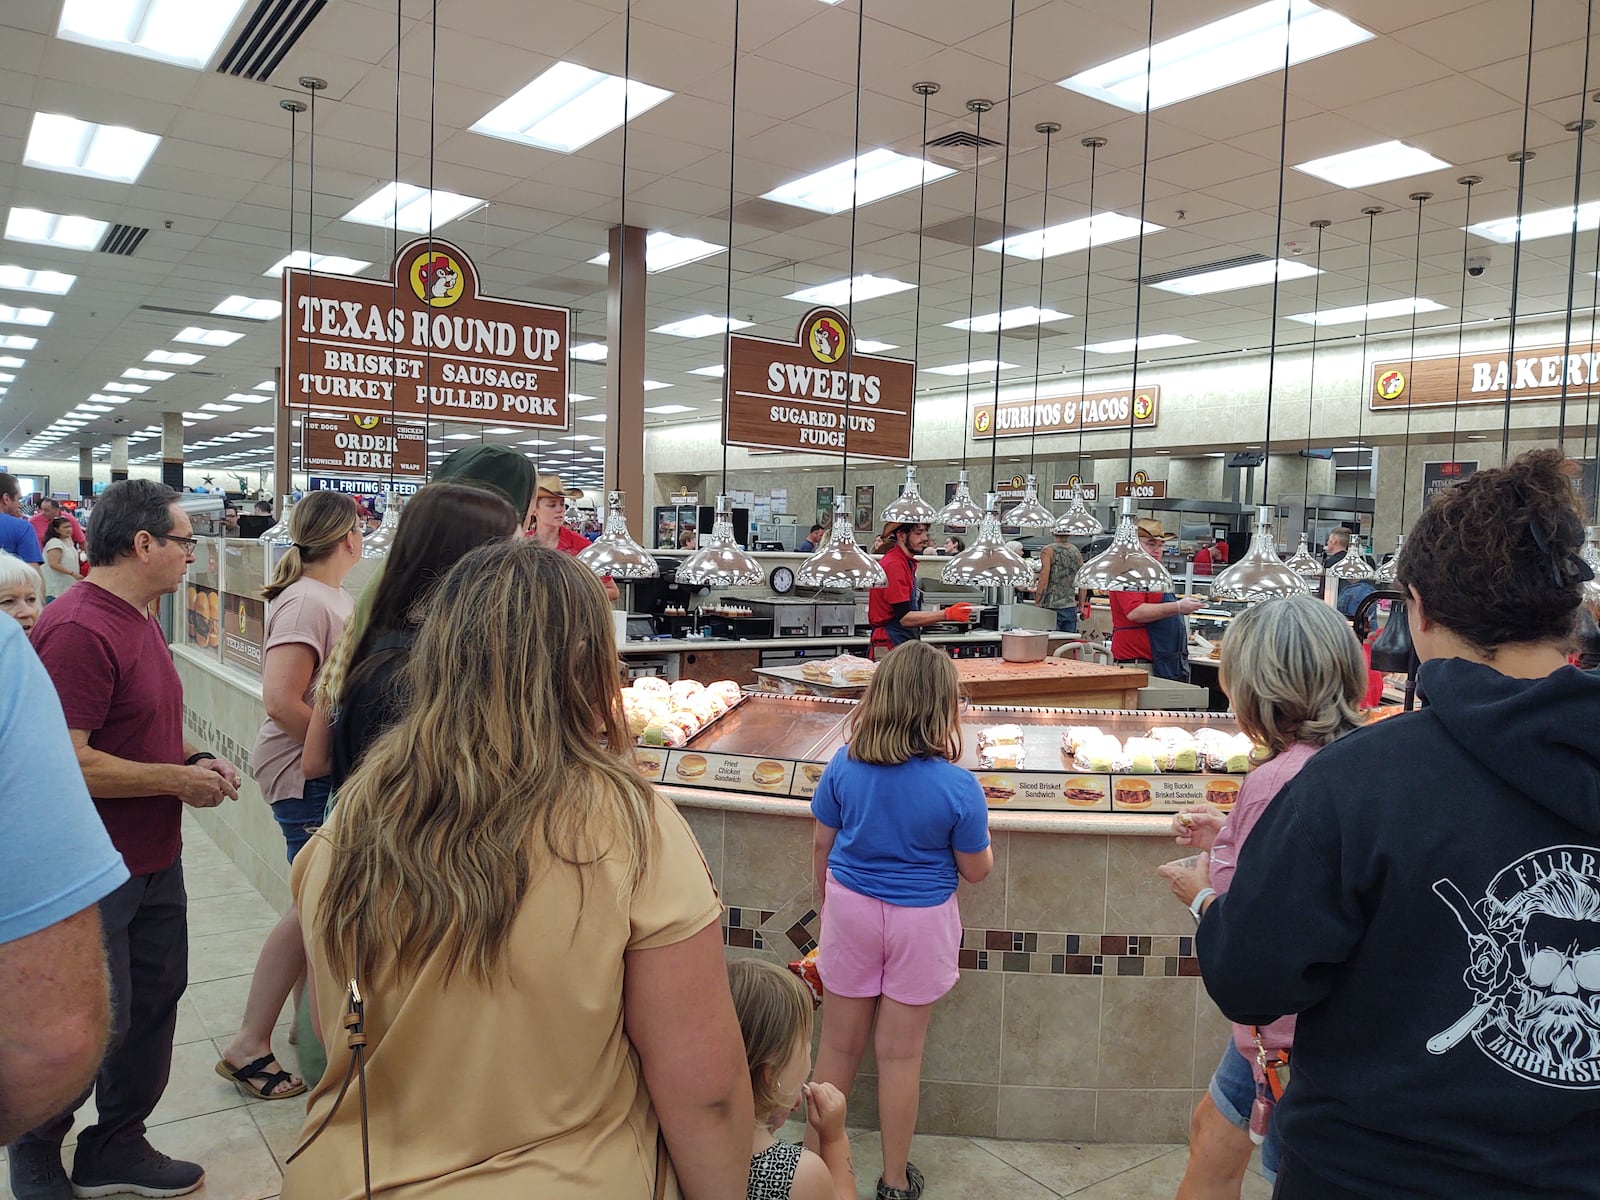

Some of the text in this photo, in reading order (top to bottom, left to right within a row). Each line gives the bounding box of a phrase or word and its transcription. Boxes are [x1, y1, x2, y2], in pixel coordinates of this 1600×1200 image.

[298, 296, 560, 362] TEXAS ROUND UP
[324, 350, 538, 391] BRISKET SAUSAGE
[768, 362, 880, 404] SWEETS
[1472, 352, 1600, 392] BAKERY
[299, 373, 558, 416] TURKEY PULLED PORK
[770, 406, 876, 432] SUGARED NUTS
[996, 396, 1128, 430] BURRITOS & TACOS
[320, 423, 338, 431] DOGS
[800, 428, 846, 447] FUDGE
[334, 432, 398, 452] ORDER
[344, 451, 394, 468] HERE
[393, 483, 417, 495] FEED
[1054, 489, 1095, 499] BUROS
[714, 774, 741, 783] Sandwich
[1514, 852, 1600, 888] FAIRB
